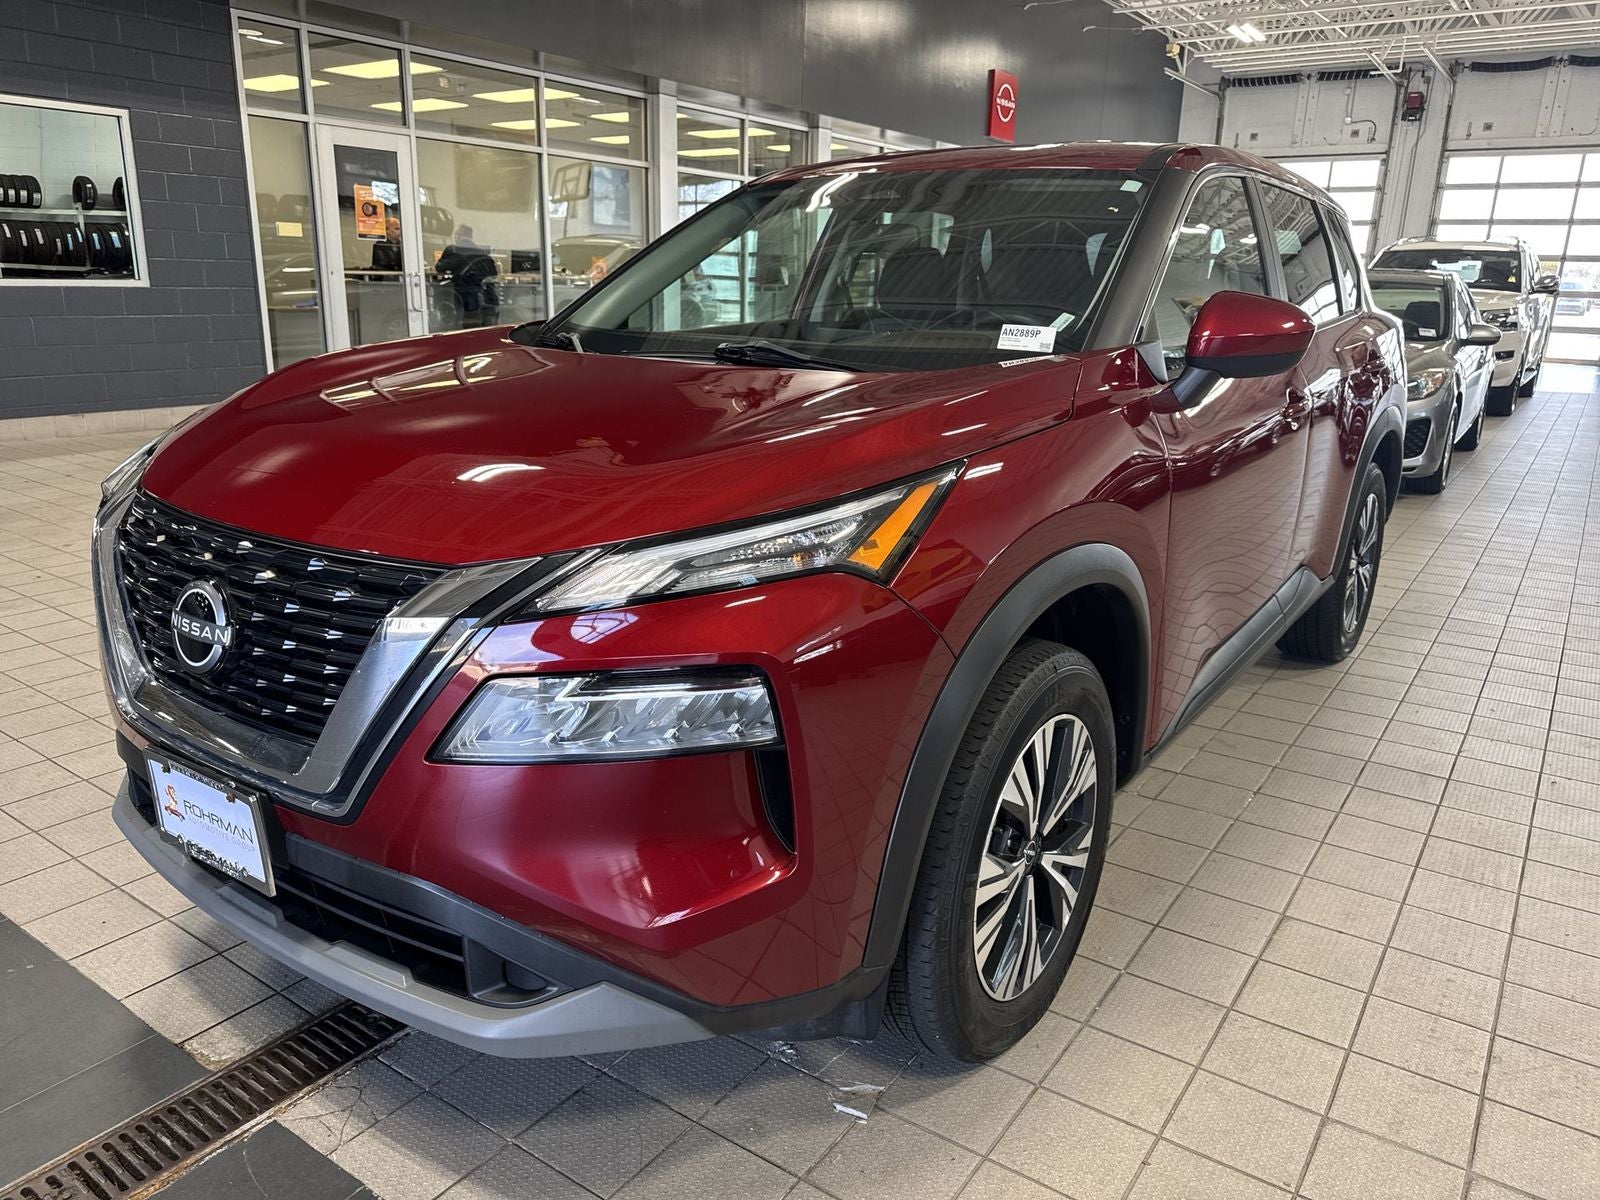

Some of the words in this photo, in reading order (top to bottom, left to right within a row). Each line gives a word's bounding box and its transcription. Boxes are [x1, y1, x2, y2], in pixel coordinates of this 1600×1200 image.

[996, 97, 1015, 109] NISSAN
[1002, 328, 1041, 338] AN2889P
[171, 611, 228, 643] NISSAN
[183, 799, 254, 844] ROHRMAN
